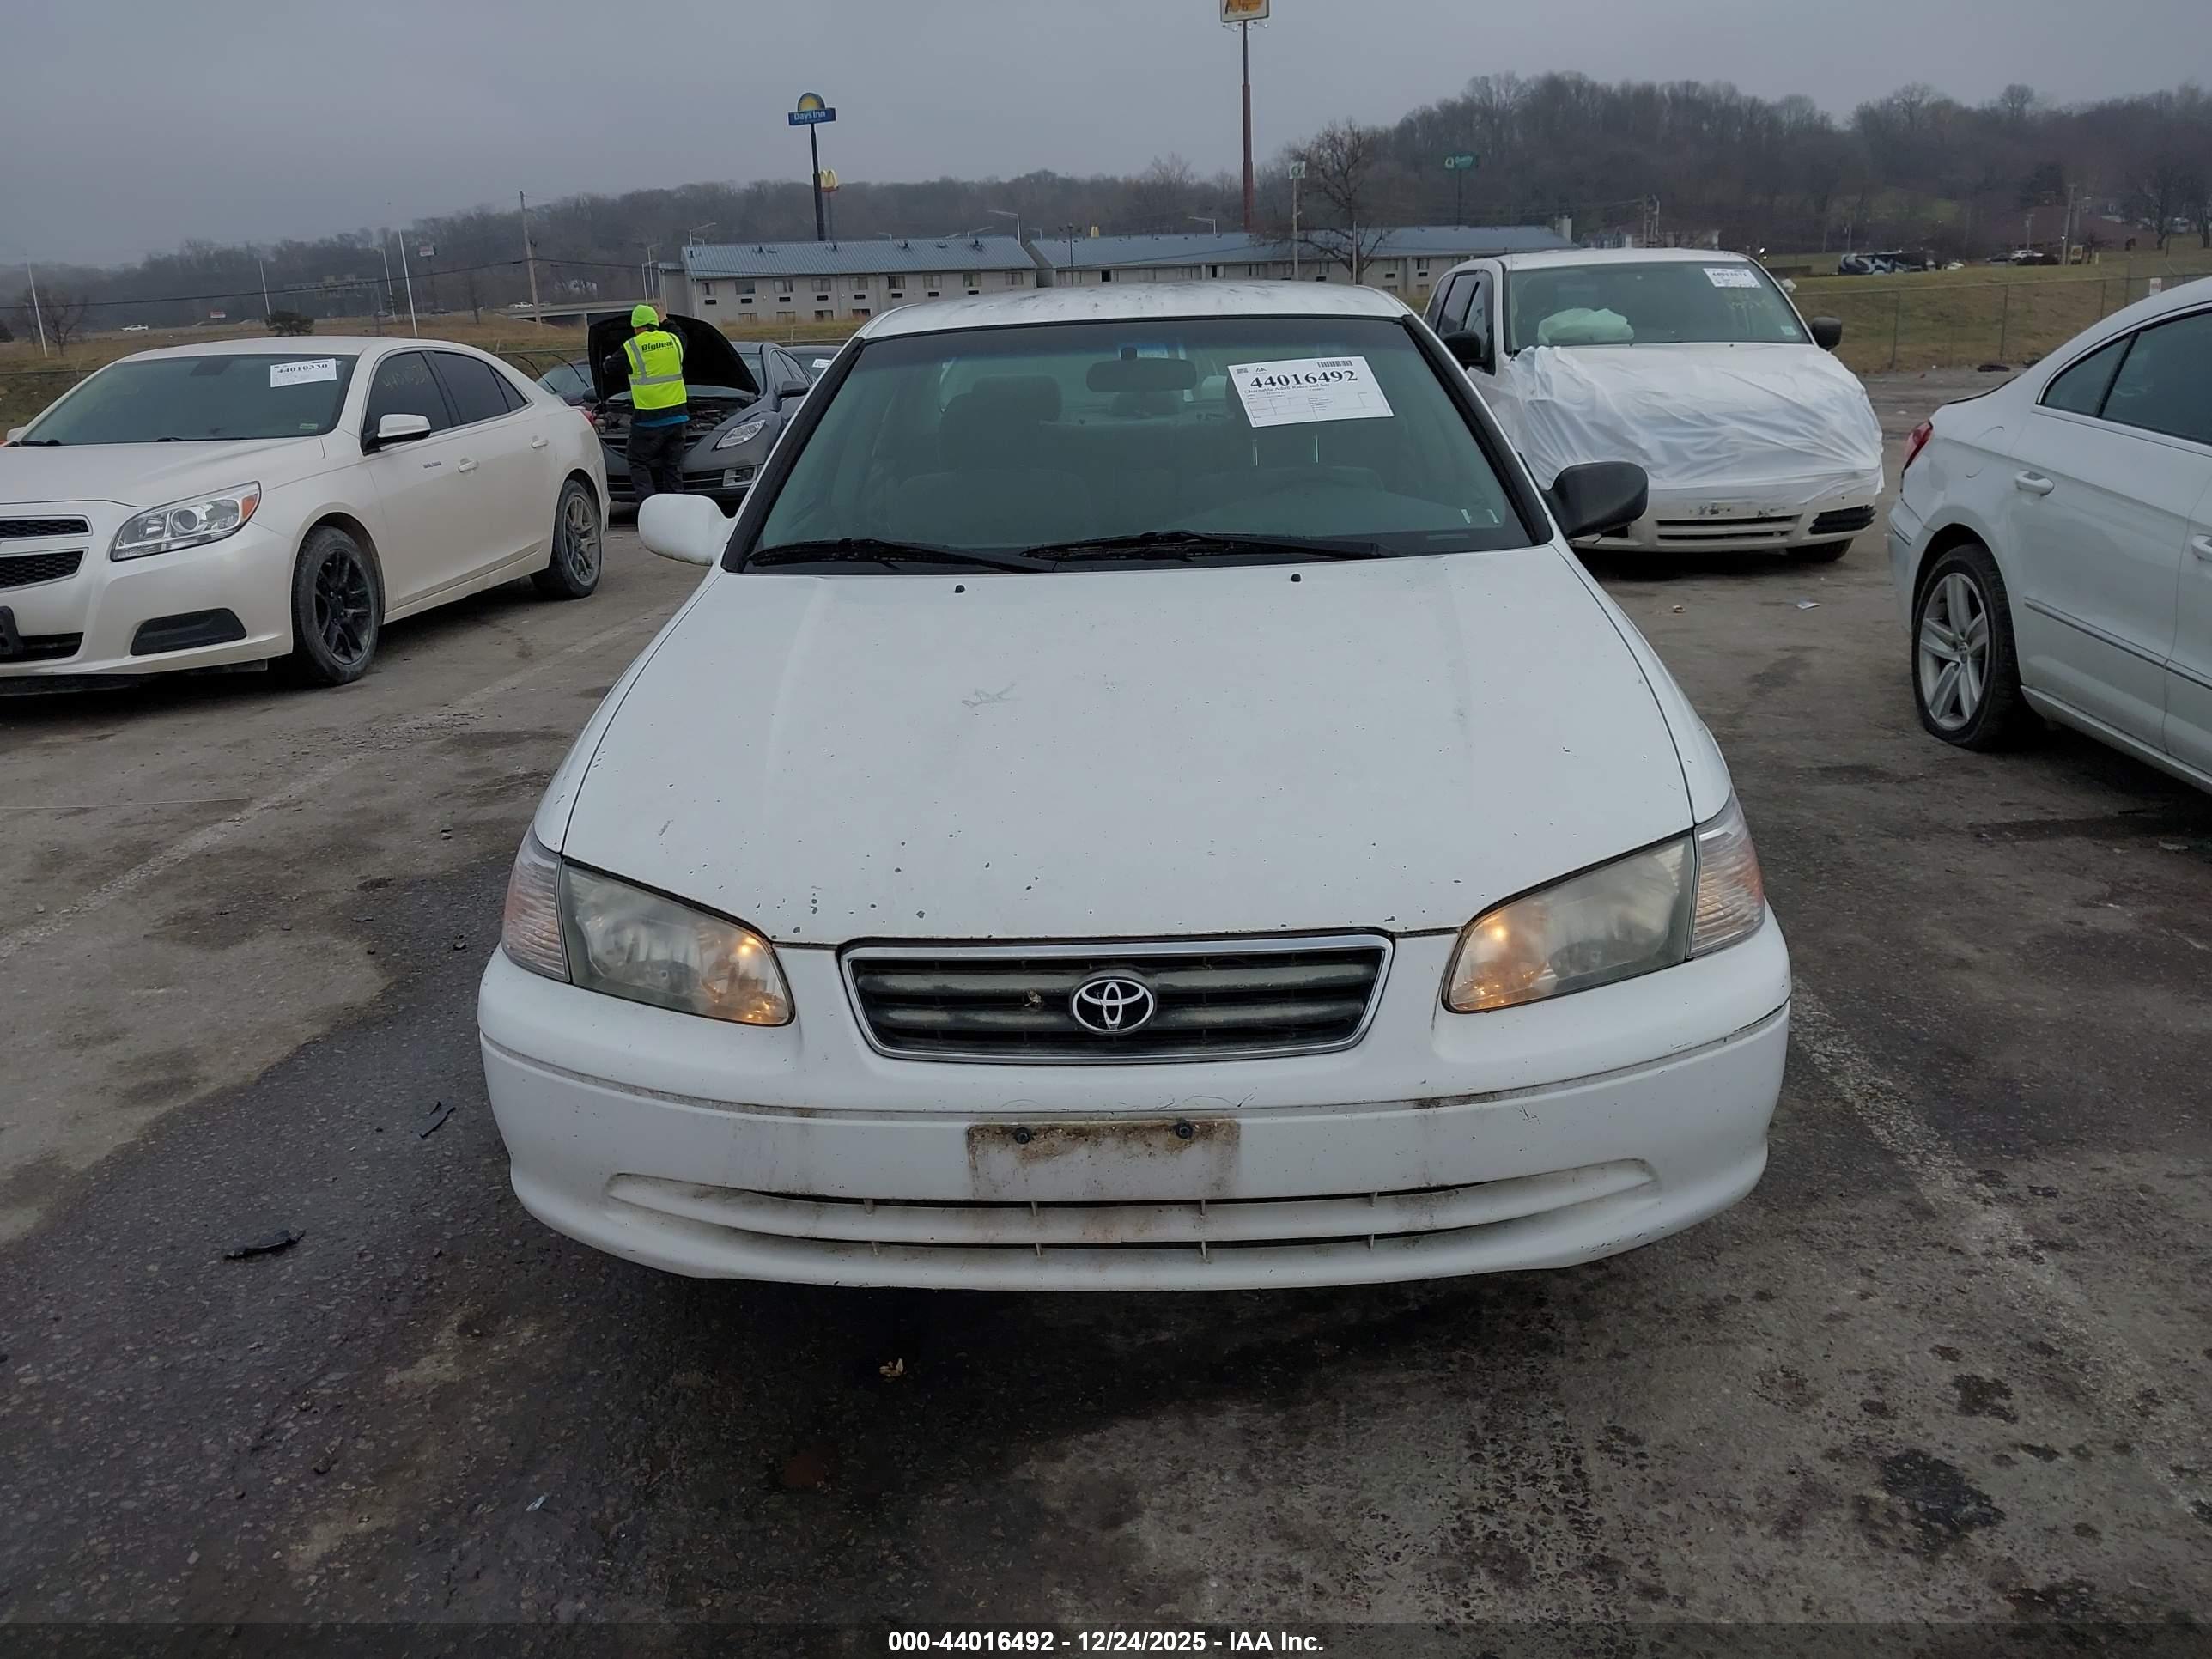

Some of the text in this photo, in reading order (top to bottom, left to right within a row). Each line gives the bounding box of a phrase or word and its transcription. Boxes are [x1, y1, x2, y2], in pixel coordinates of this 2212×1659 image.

[793, 110, 826, 121] Days Inn
[641, 340, 673, 351] BigDeal
[1250, 370, 1358, 388] 44016492
